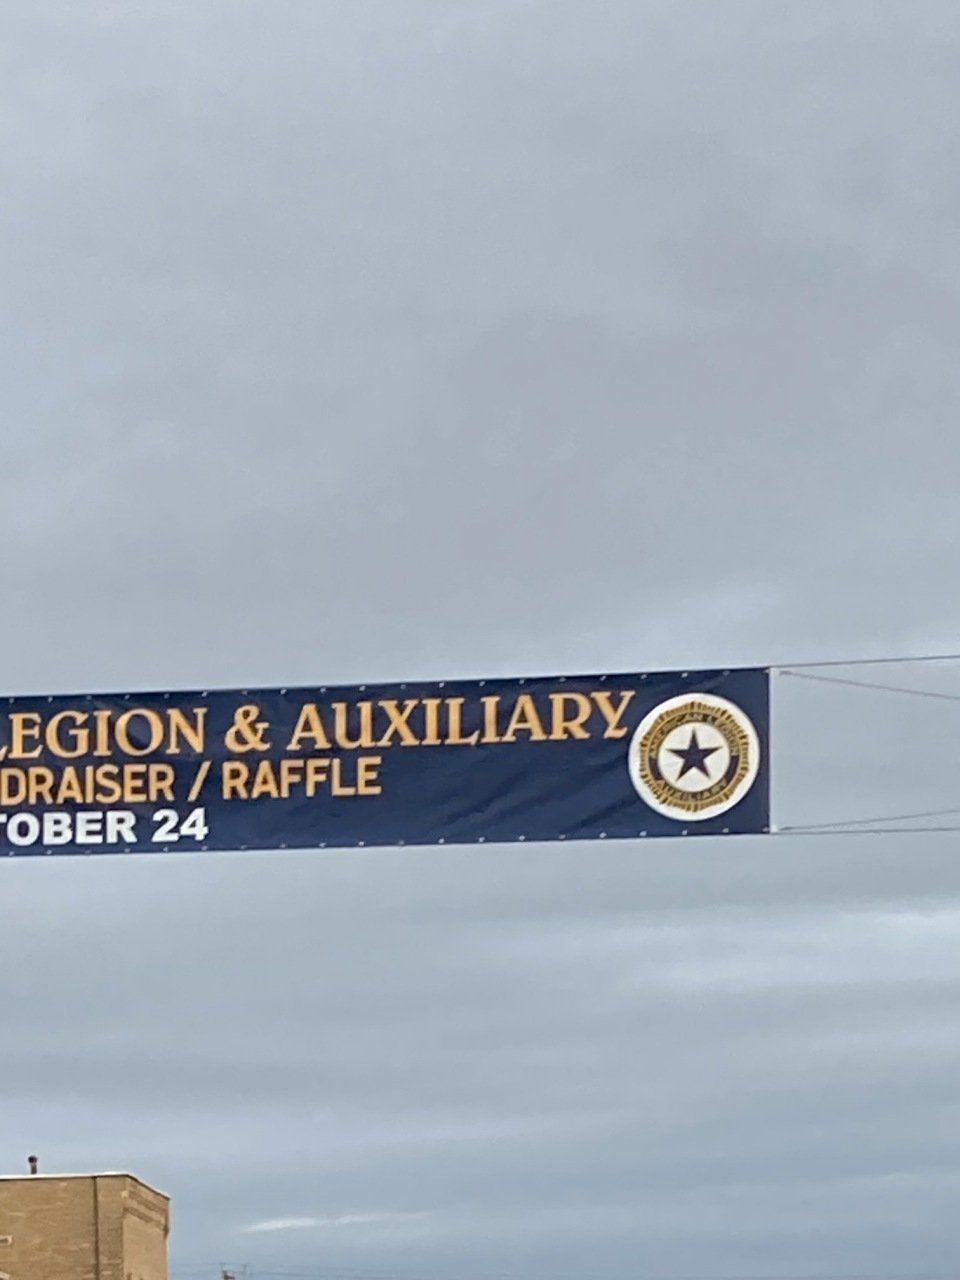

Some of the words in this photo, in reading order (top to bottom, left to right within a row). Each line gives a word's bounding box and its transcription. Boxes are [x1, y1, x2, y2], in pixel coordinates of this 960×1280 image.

[225, 704, 270, 753] &
[287, 690, 636, 753] AUXILIARY
[187, 760, 211, 802] /
[222, 756, 382, 800] RAFFLE
[151, 807, 208, 843] 24
